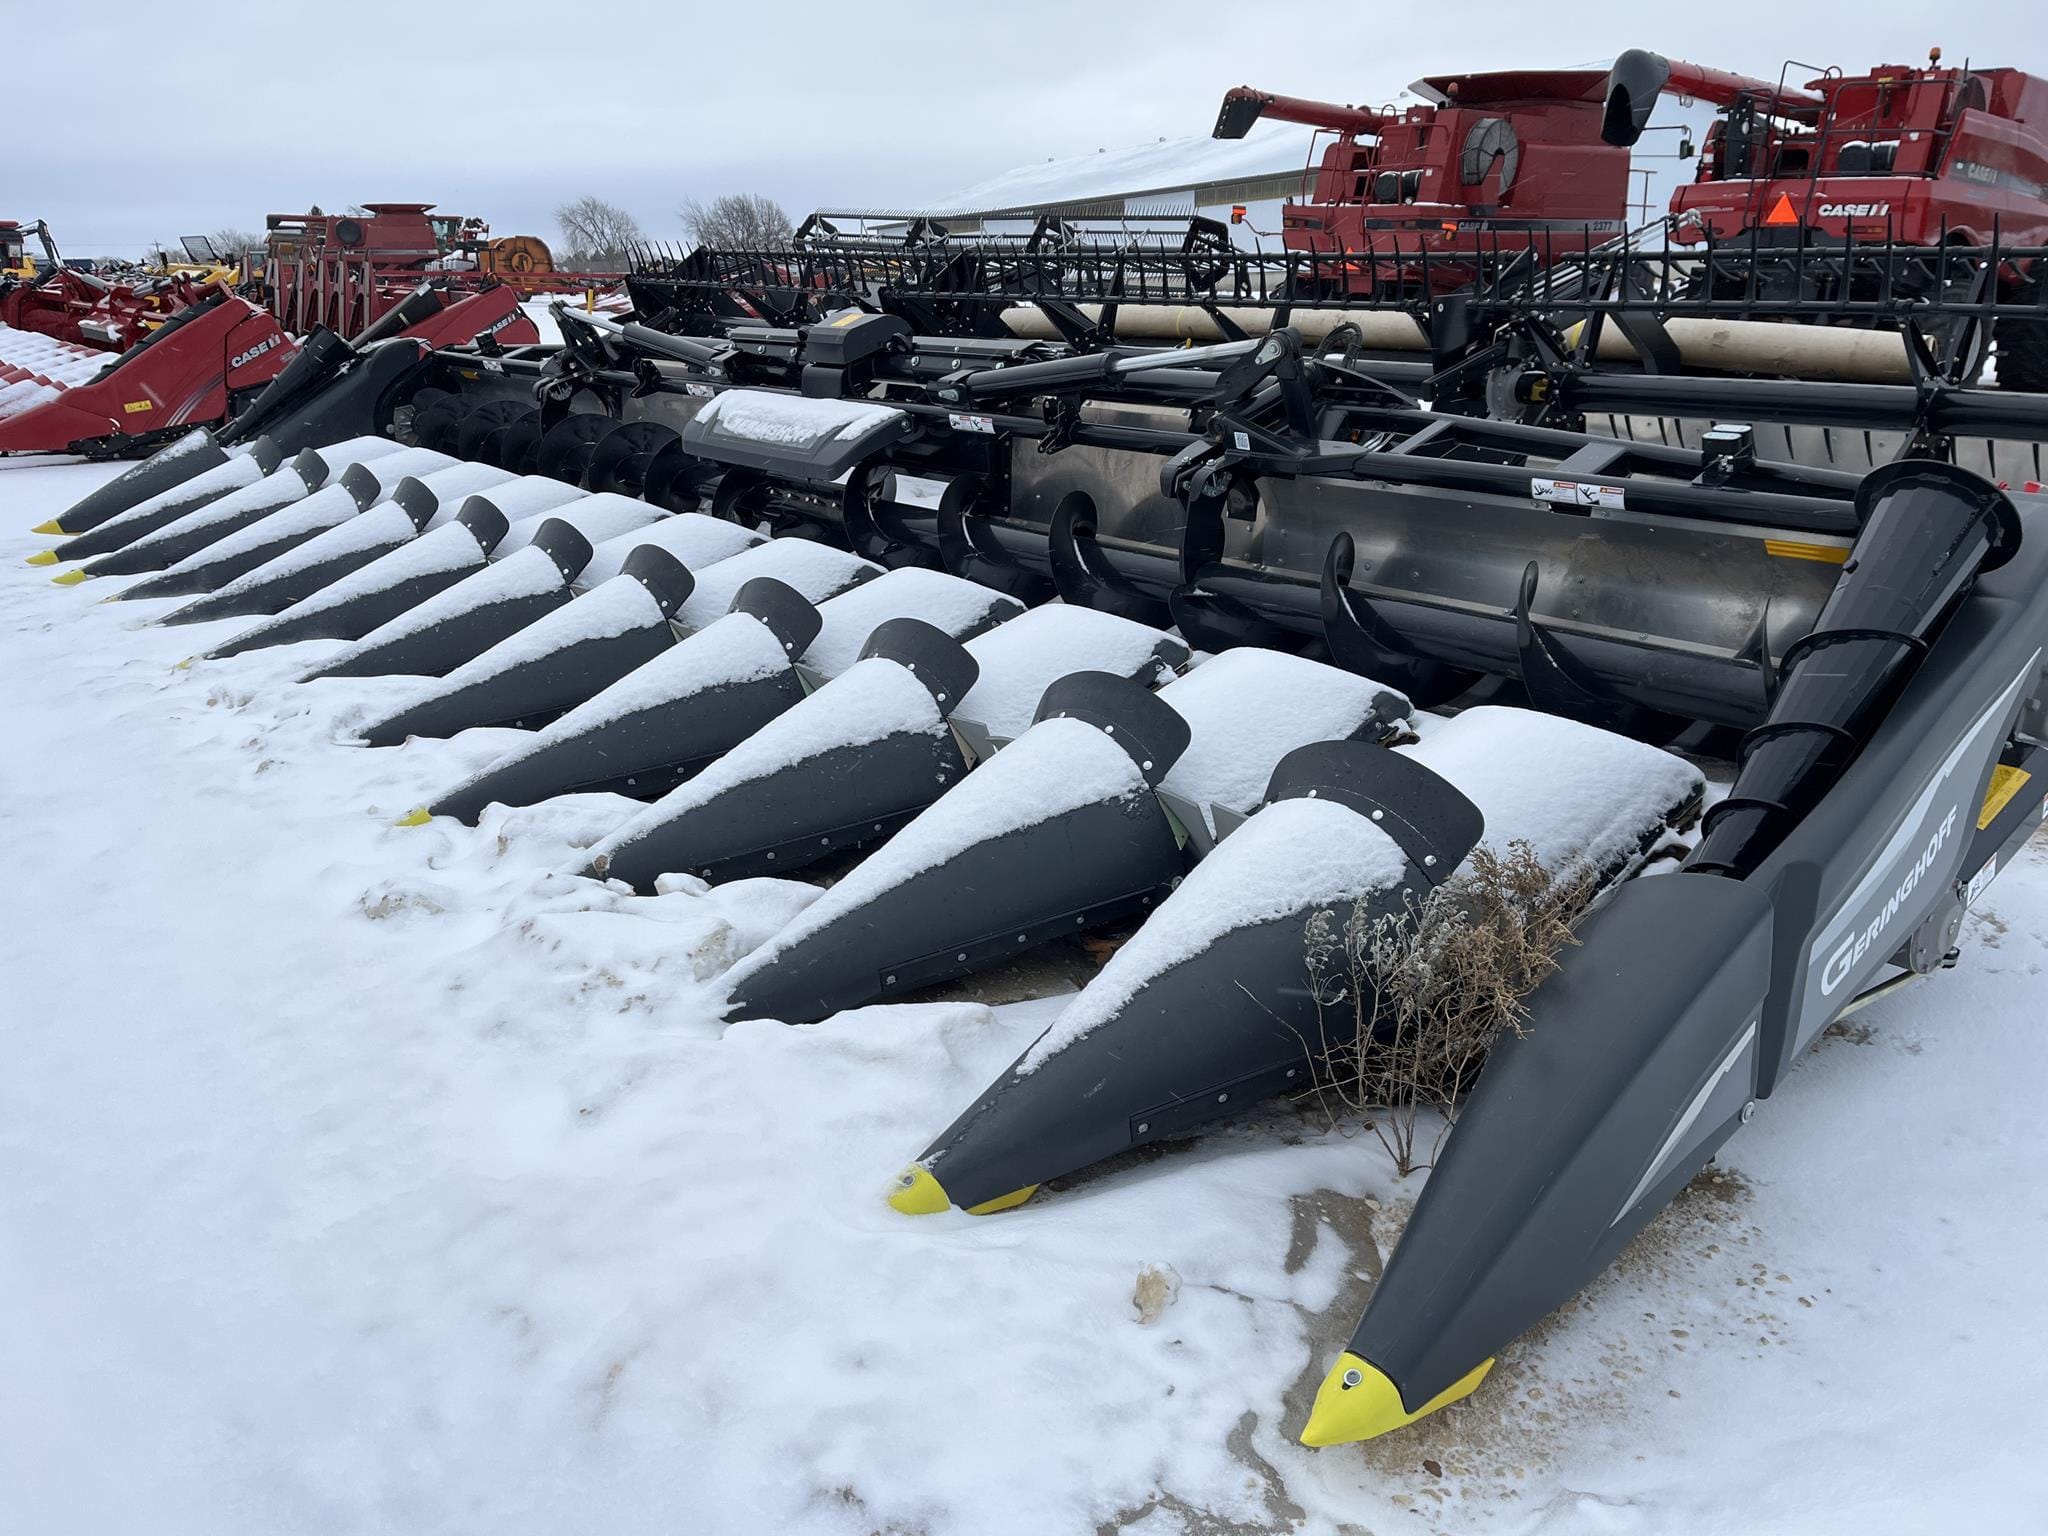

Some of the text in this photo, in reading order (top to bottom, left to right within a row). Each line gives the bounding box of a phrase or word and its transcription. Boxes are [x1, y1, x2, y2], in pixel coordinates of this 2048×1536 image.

[1818, 203, 1871, 216] CASE
[1592, 221, 1613, 231] 2377
[231, 341, 269, 368] CASE
[1821, 804, 1957, 996] GERINGHOFF
